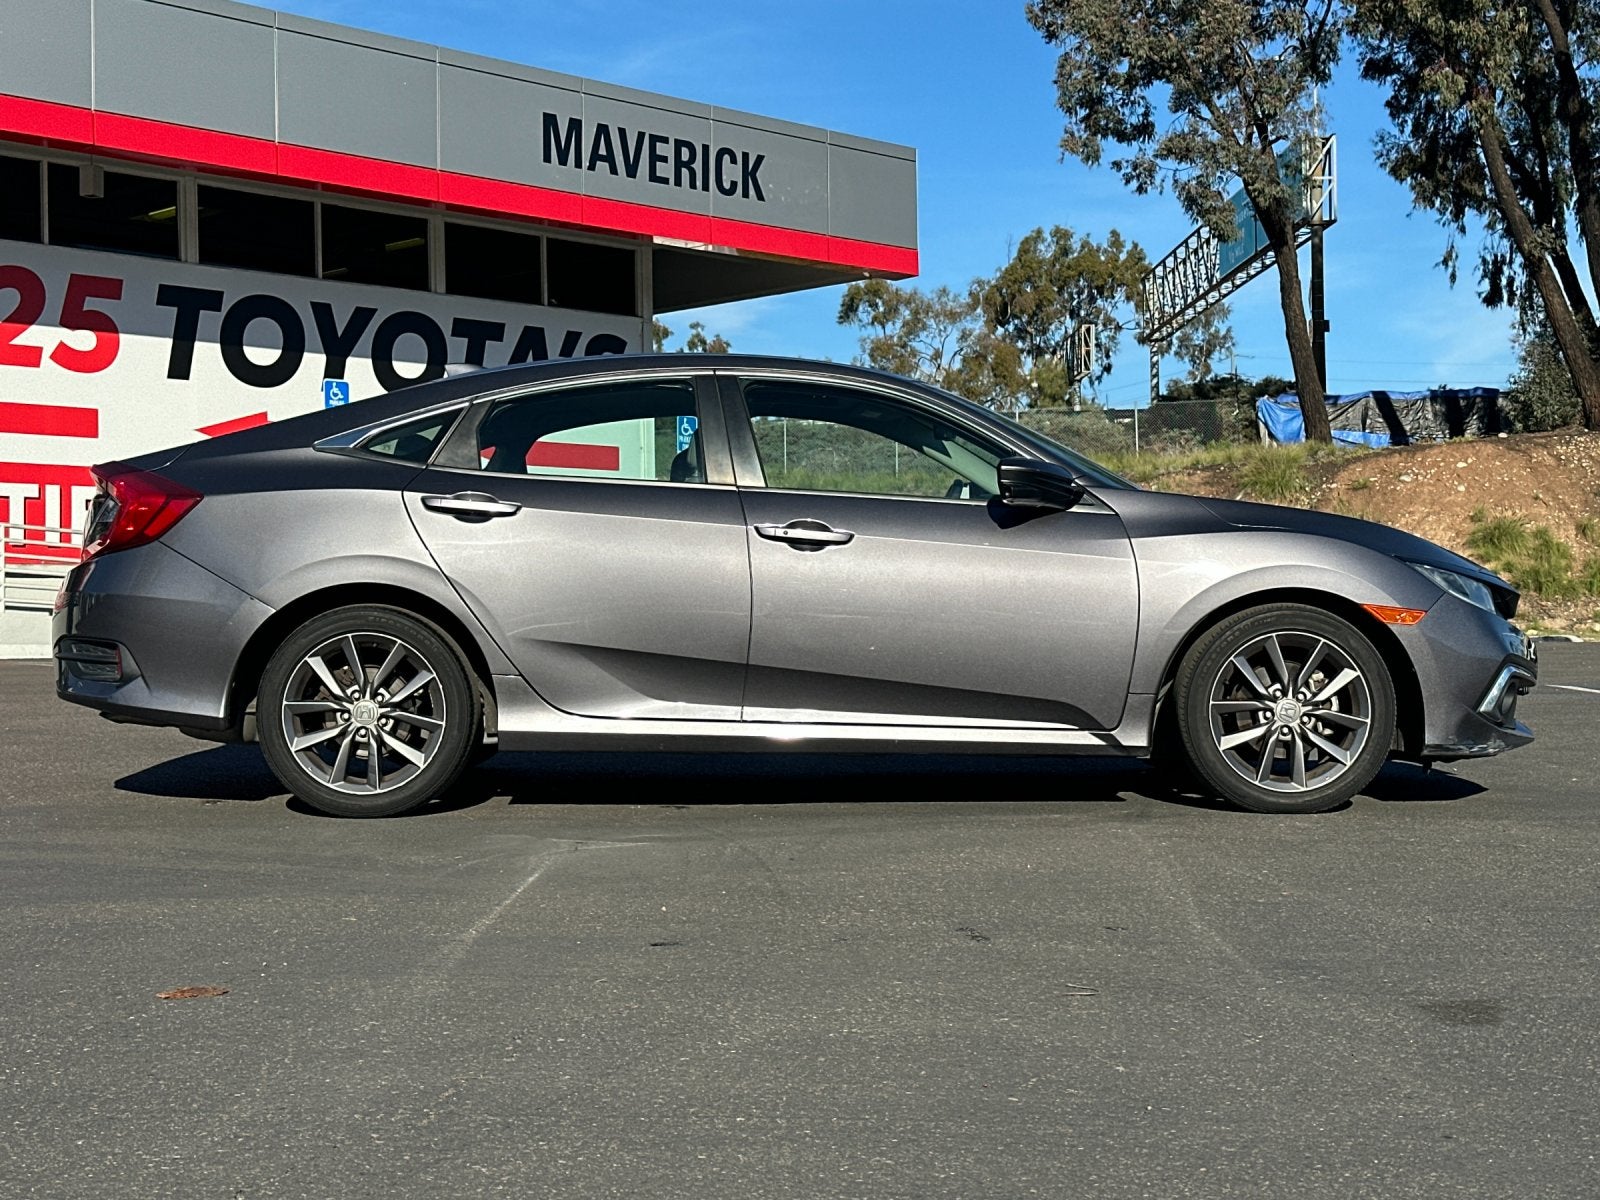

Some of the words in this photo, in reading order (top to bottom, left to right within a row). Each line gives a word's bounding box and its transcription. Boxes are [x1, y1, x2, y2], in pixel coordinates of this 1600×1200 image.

[542, 112, 766, 202] MAVERICK
[0, 265, 124, 373] 25
[155, 283, 628, 392] TOYOT'
